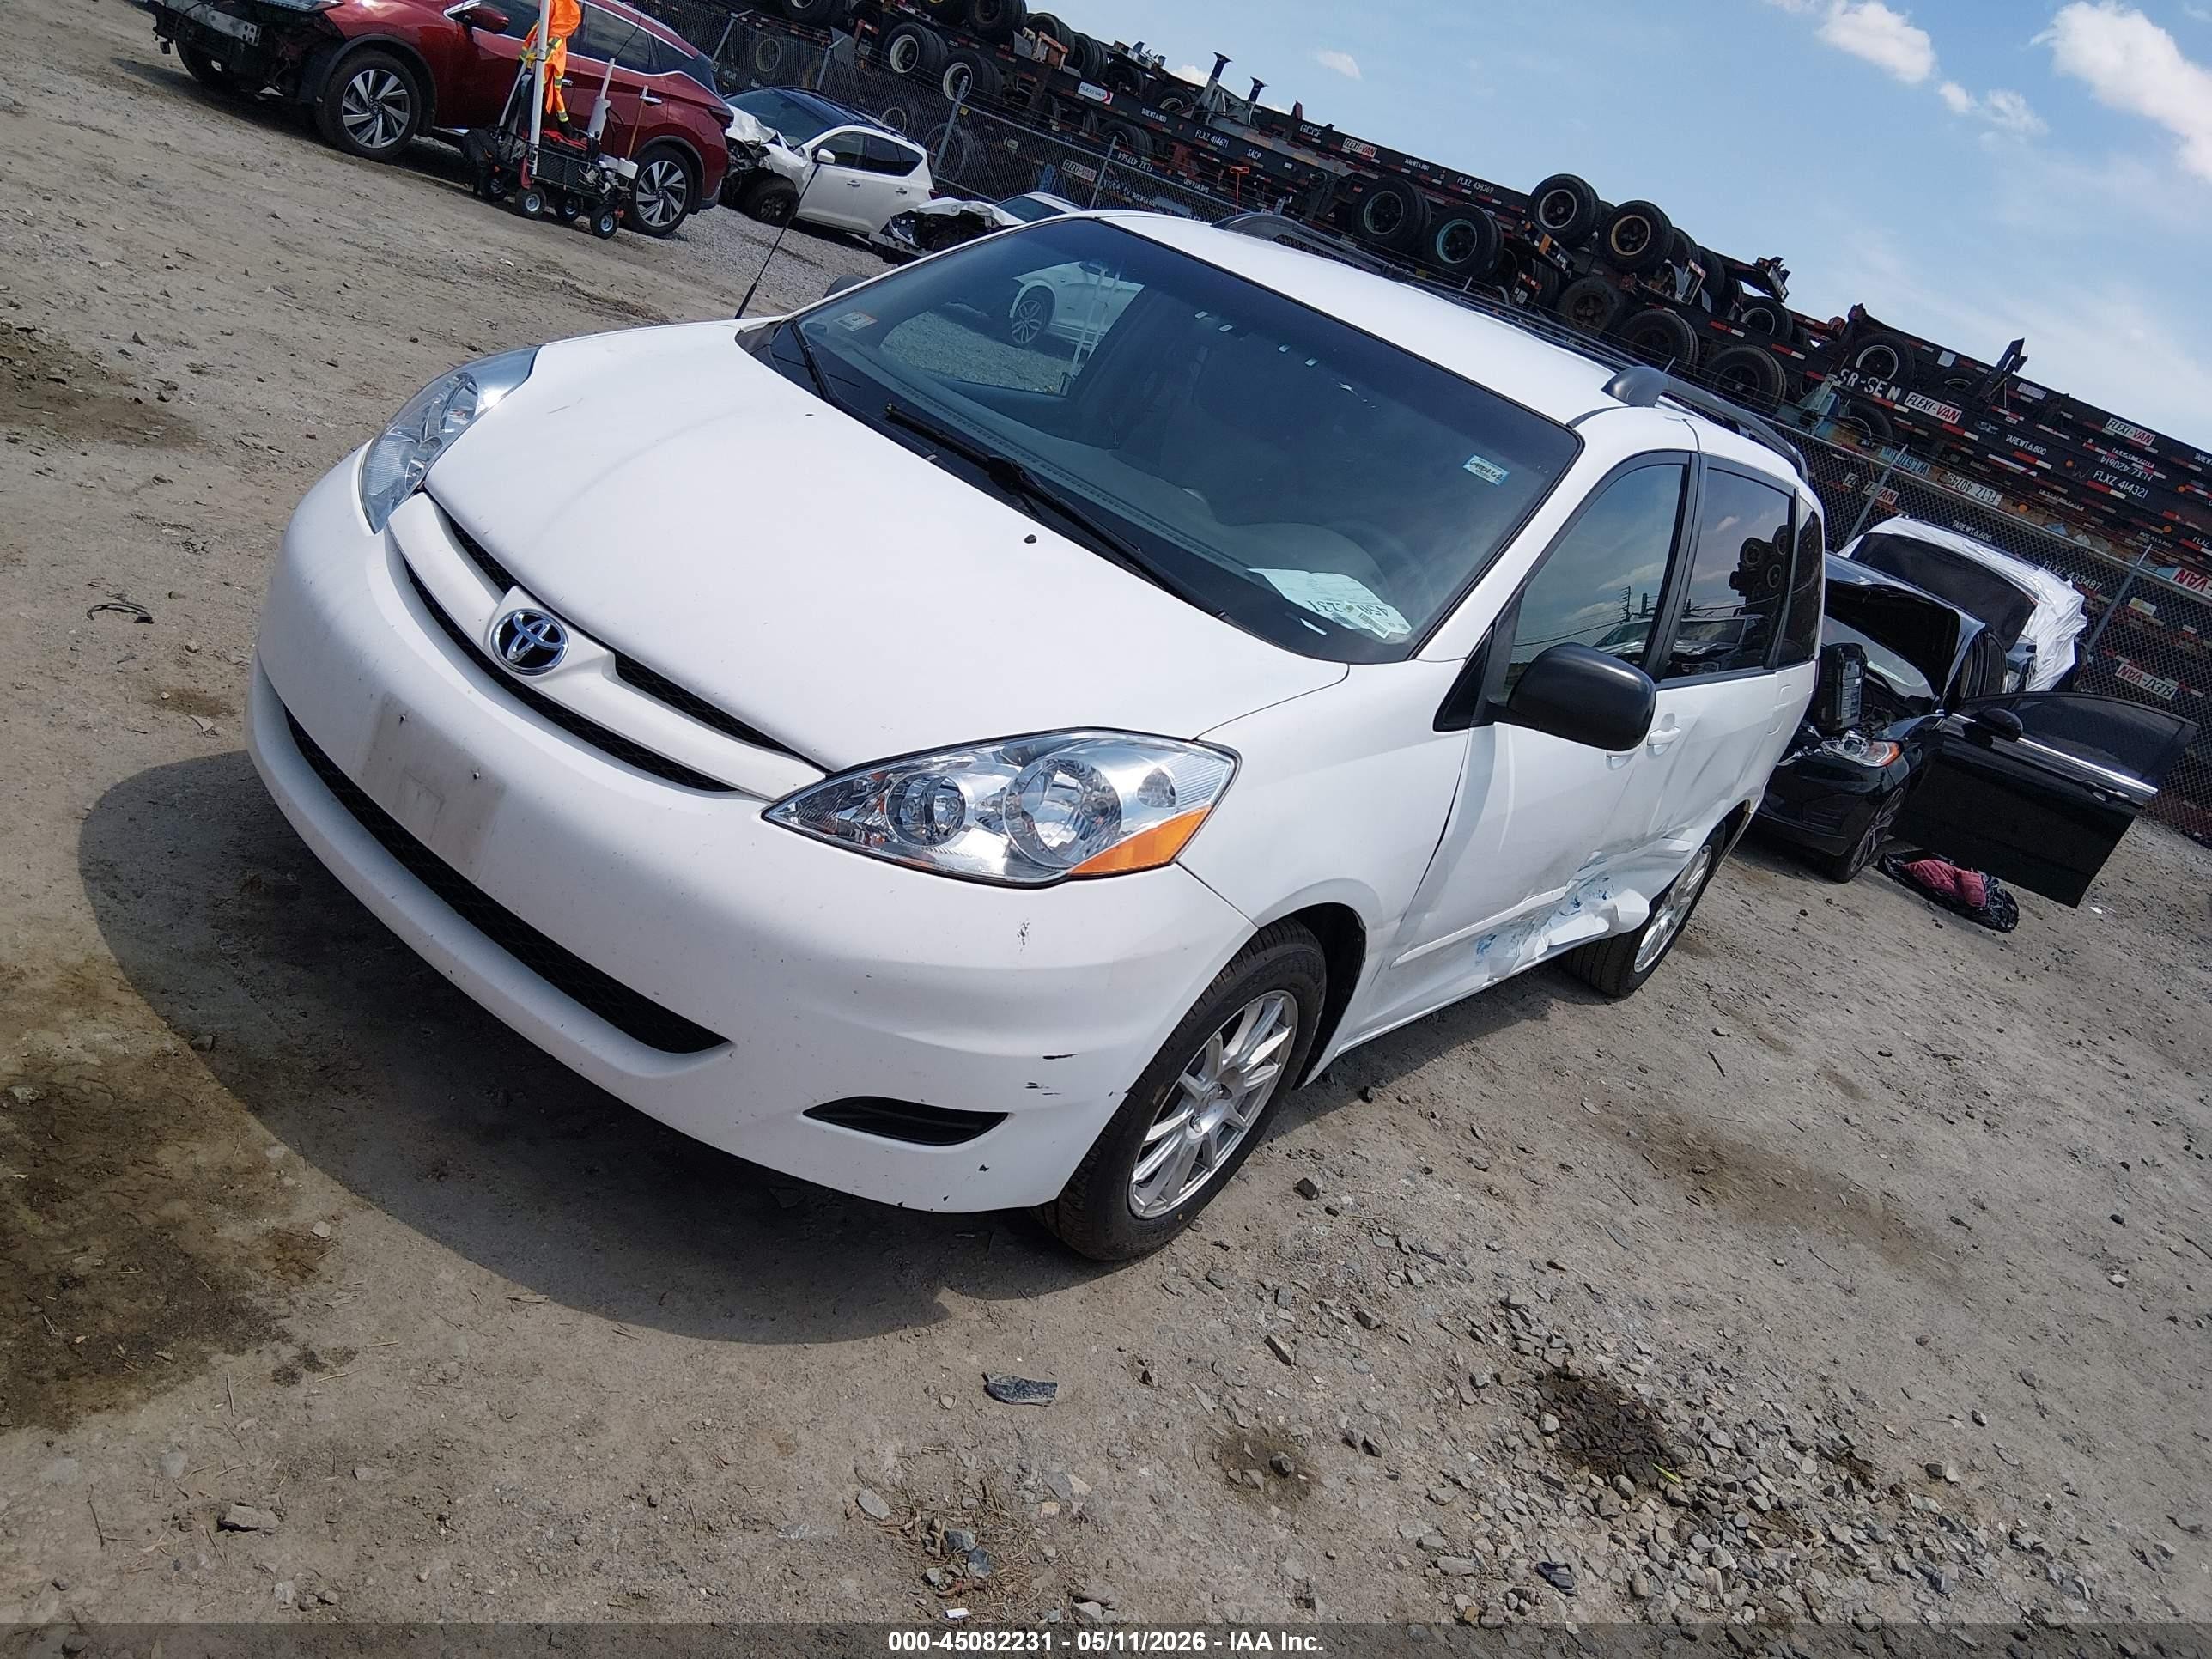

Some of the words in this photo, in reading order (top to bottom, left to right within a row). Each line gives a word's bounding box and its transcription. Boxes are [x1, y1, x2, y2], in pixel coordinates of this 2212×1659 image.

[1194, 129, 1210, 141] FLXZ
[1209, 134, 1229, 148] 414671
[1343, 138, 1375, 156] FLEXI-VAN
[1138, 161, 1153, 172] FLXZ
[1456, 176, 1472, 186] FLXZ
[1472, 180, 1494, 195] 438369
[1905, 392, 1960, 422] FLEXI-VAN
[2107, 419, 2154, 443] FLEXI-VAN
[2093, 470, 2118, 486] FLXZ
[2116, 478, 2148, 499] 414321
[2042, 559, 2065, 576] FLXZ
[2066, 571, 2102, 592] 433487
[2118, 665, 2175, 698] FLEXI-VAN
